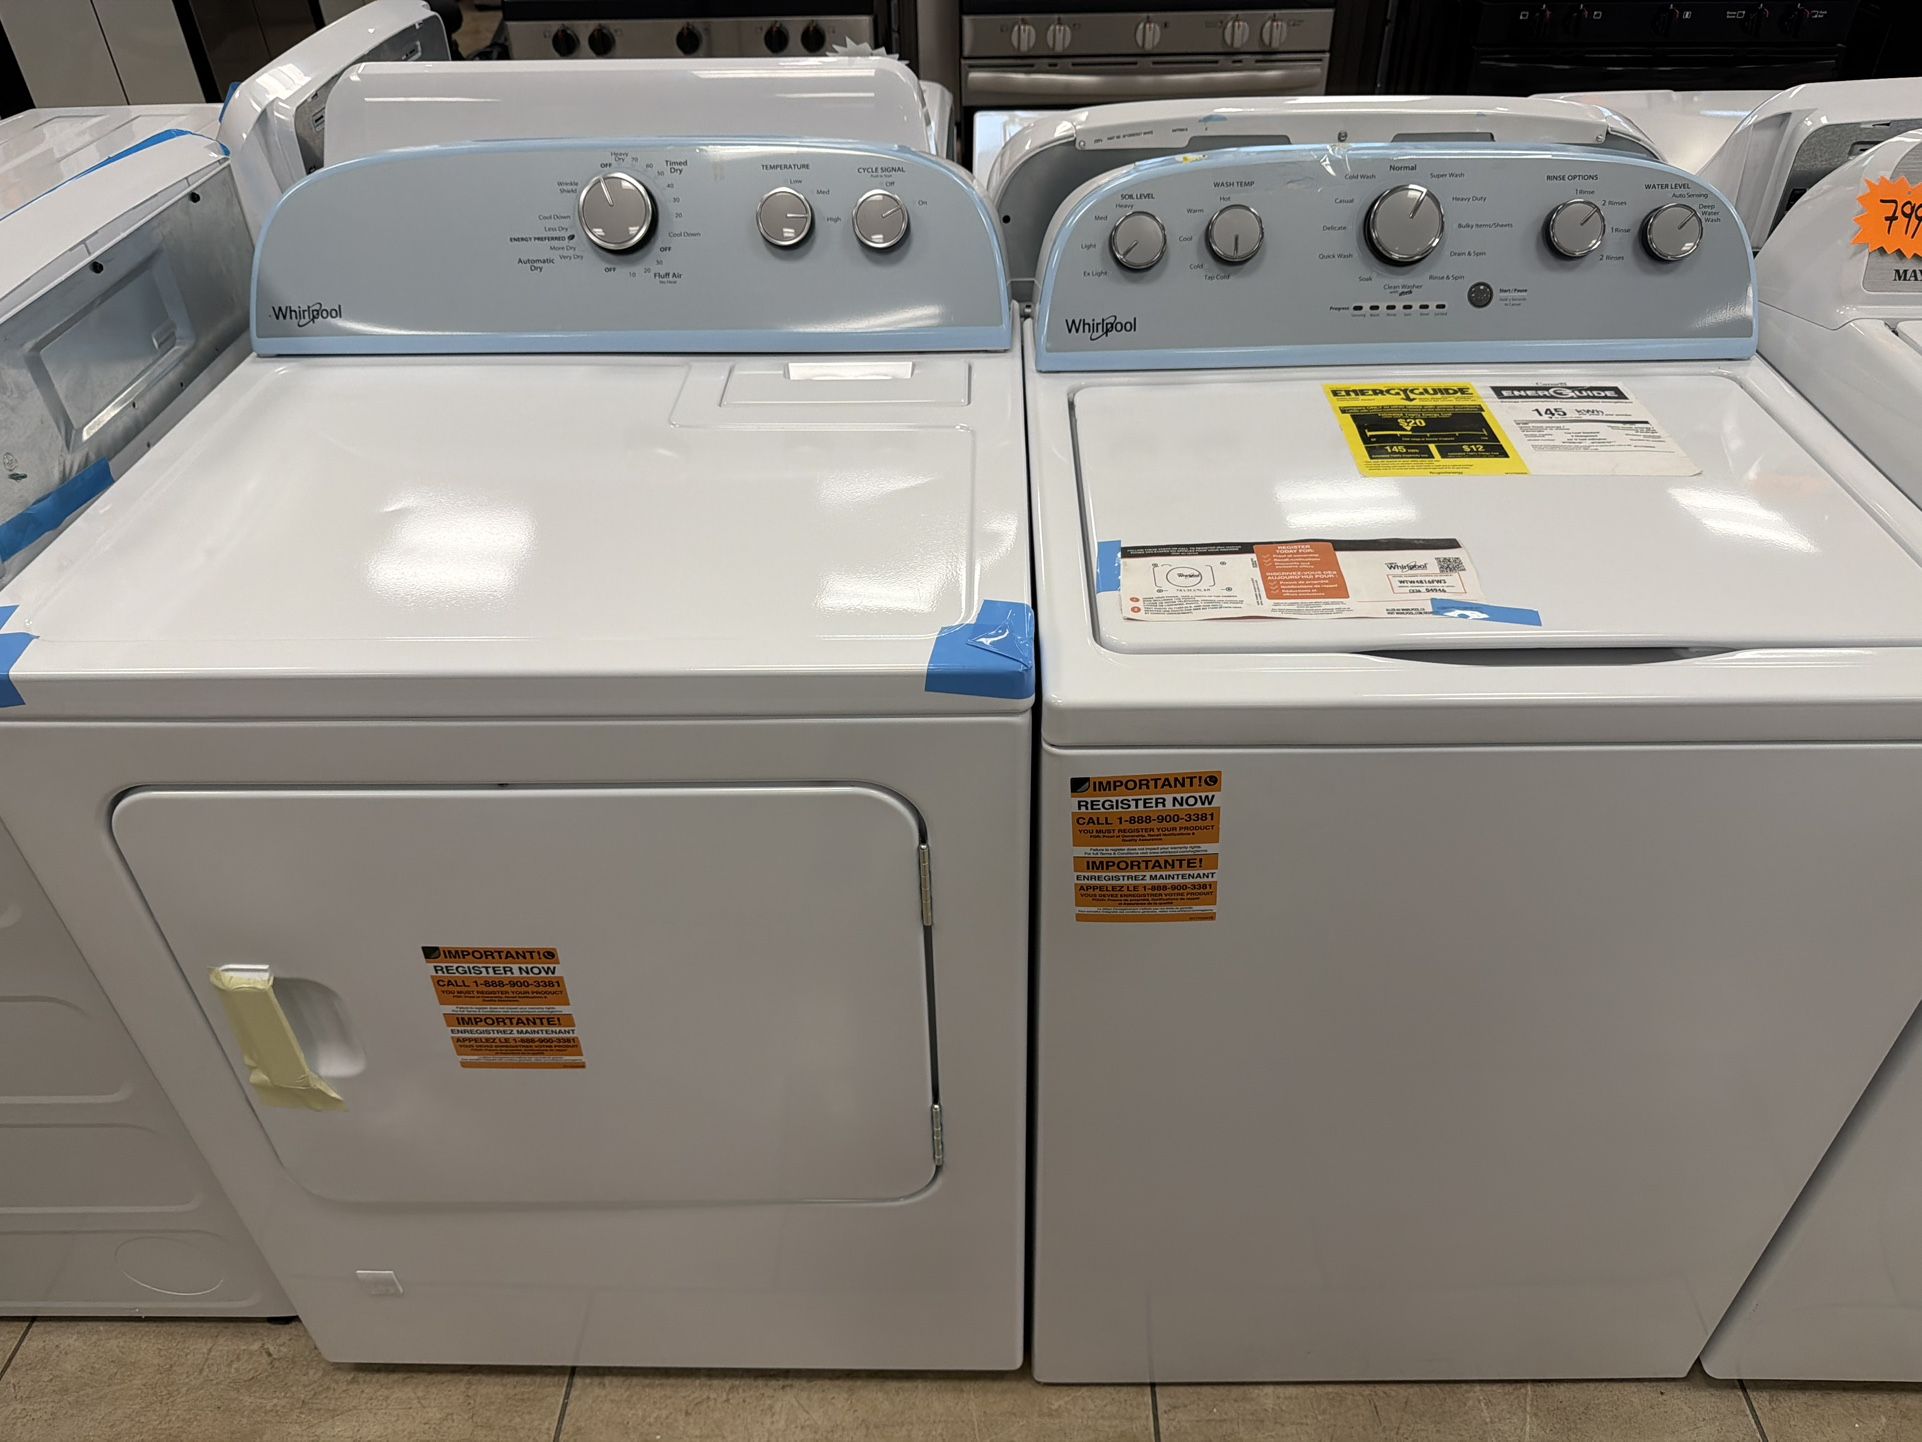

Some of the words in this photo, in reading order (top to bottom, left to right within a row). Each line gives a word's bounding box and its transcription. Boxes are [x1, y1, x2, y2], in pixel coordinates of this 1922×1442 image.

[670, 167, 683, 175] Dry
[1894, 269, 1922, 281] MA
[272, 302, 342, 328] Whirlpool
[1065, 315, 1137, 341] Whirlpool
[1331, 388, 1474, 400] ENERGYGUIDE
[1501, 388, 1618, 399] ENERGUIDE
[1532, 408, 1567, 417] 145
[1398, 419, 1426, 428] $20
[1385, 561, 1428, 573] Whirlpool
[1093, 776, 1202, 792] IMPORTANT!
[1078, 797, 1166, 811] REGISTER
[1172, 795, 1215, 808] NOW
[1076, 816, 1113, 826] CALL
[1117, 812, 1214, 825] 1-888-900-3381
[1086, 858, 1203, 871] IMPORTANTE!
[1076, 874, 1147, 882] ENREGISTREZ
[1149, 872, 1216, 881] MAINTENANT
[443, 950, 542, 960] IMPORTANT!
[434, 966, 514, 975] REGISTER
[520, 966, 556, 975] NOW
[437, 980, 470, 988] CALL
[474, 980, 561, 988] 1-888-900-3381
[456, 1017, 561, 1026] IMPORTANTE!
